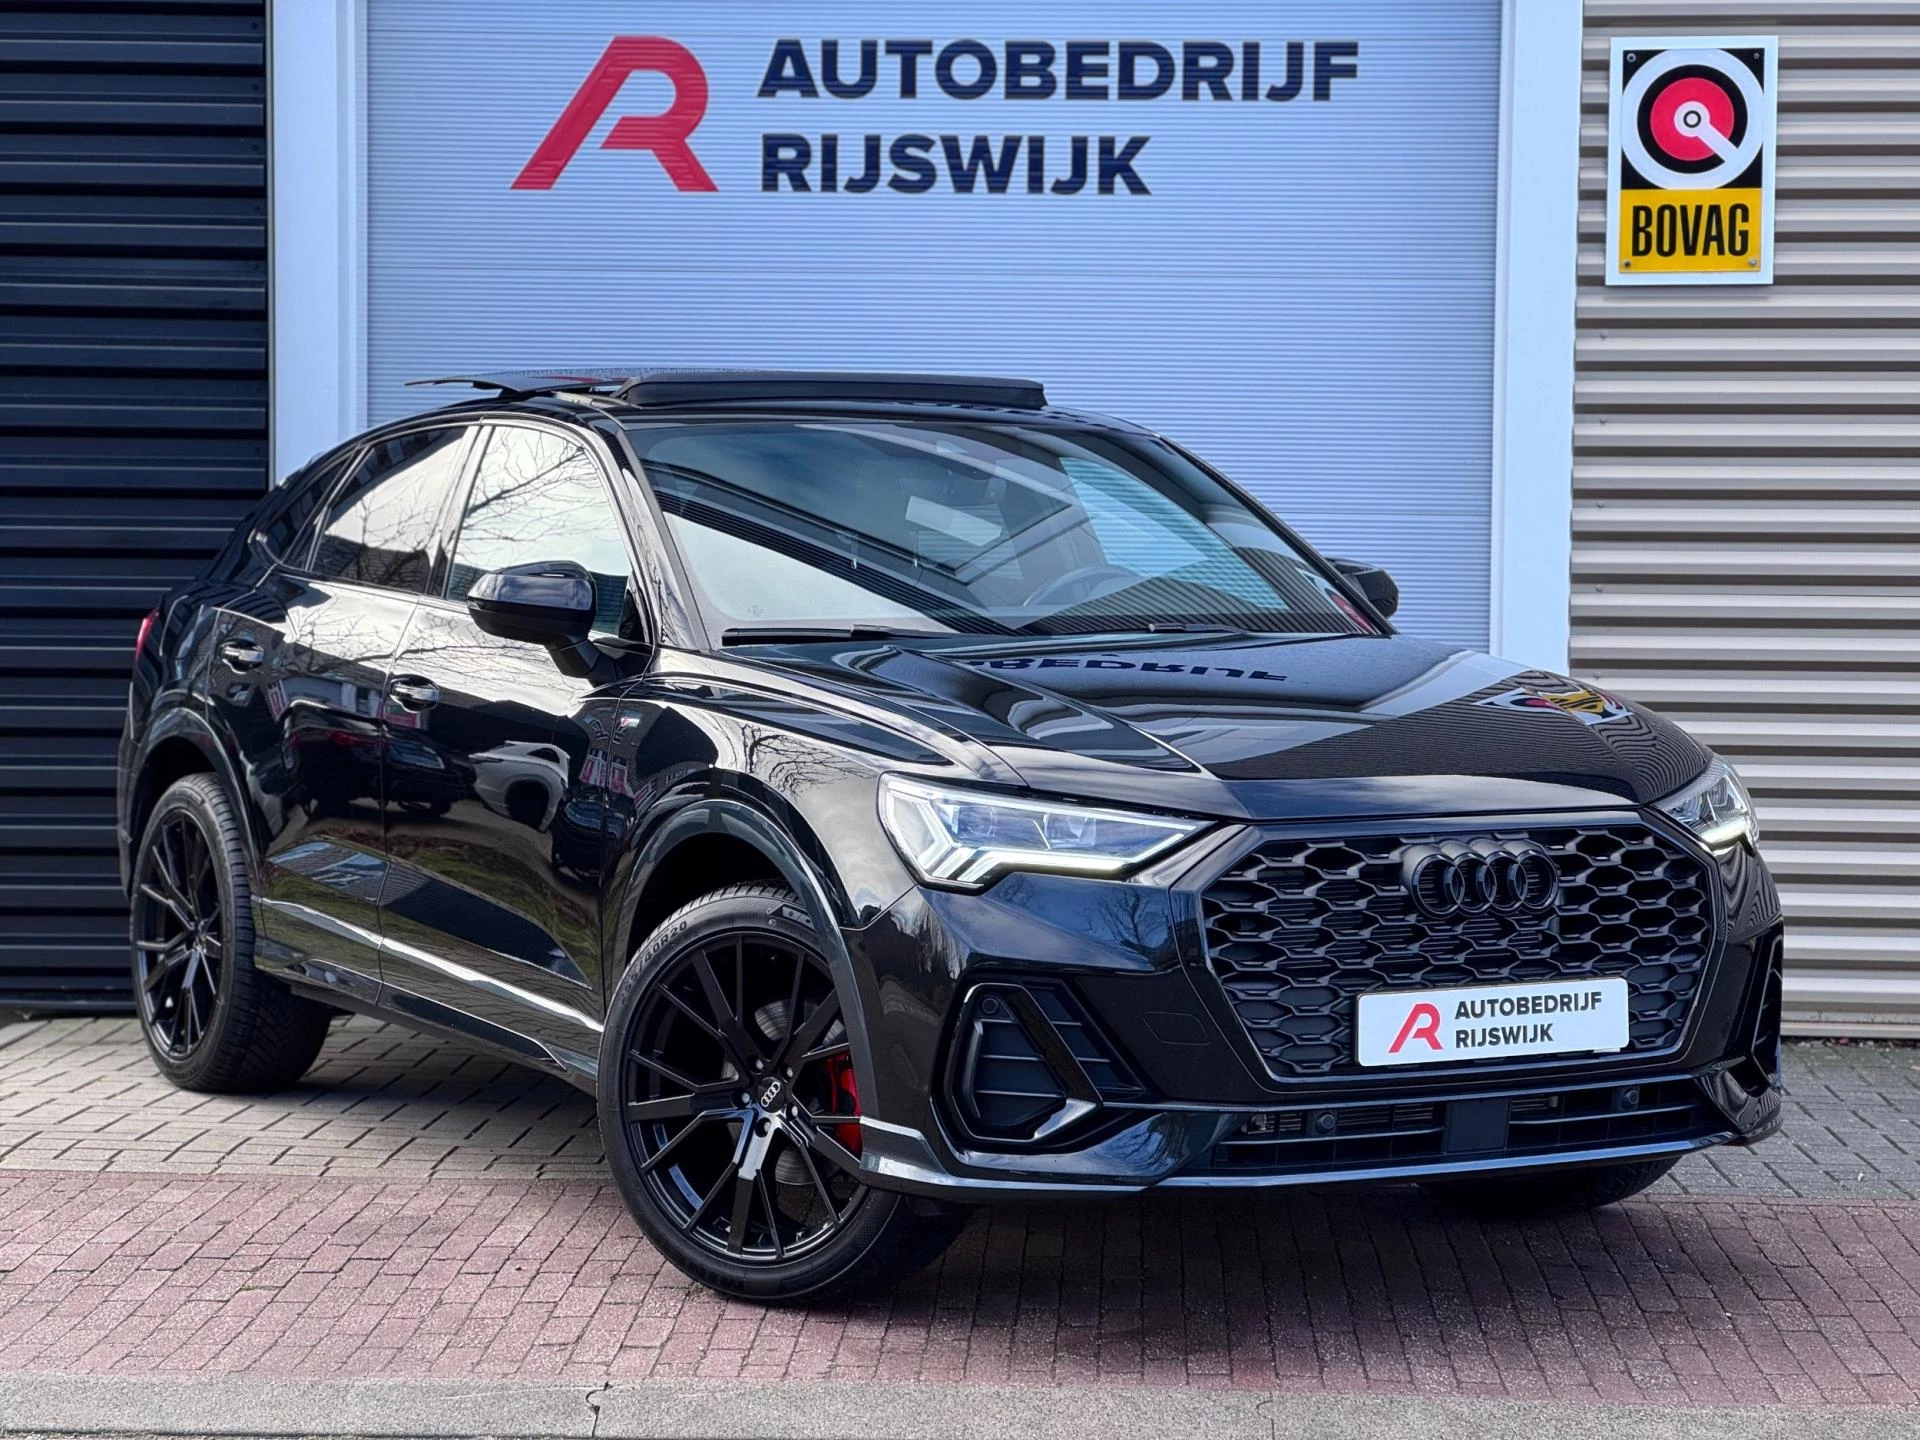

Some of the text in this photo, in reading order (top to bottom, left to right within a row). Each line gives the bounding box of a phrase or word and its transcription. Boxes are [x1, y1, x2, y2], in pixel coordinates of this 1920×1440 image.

[757, 39, 1359, 102] AUTOBEDRIJF
[762, 134, 1151, 195] RIJSWIJK
[1631, 203, 1750, 258] BOVAG
[1454, 991, 1602, 1020] AUTOBEDRIJF
[1455, 1022, 1554, 1048] RIJSWIJK
